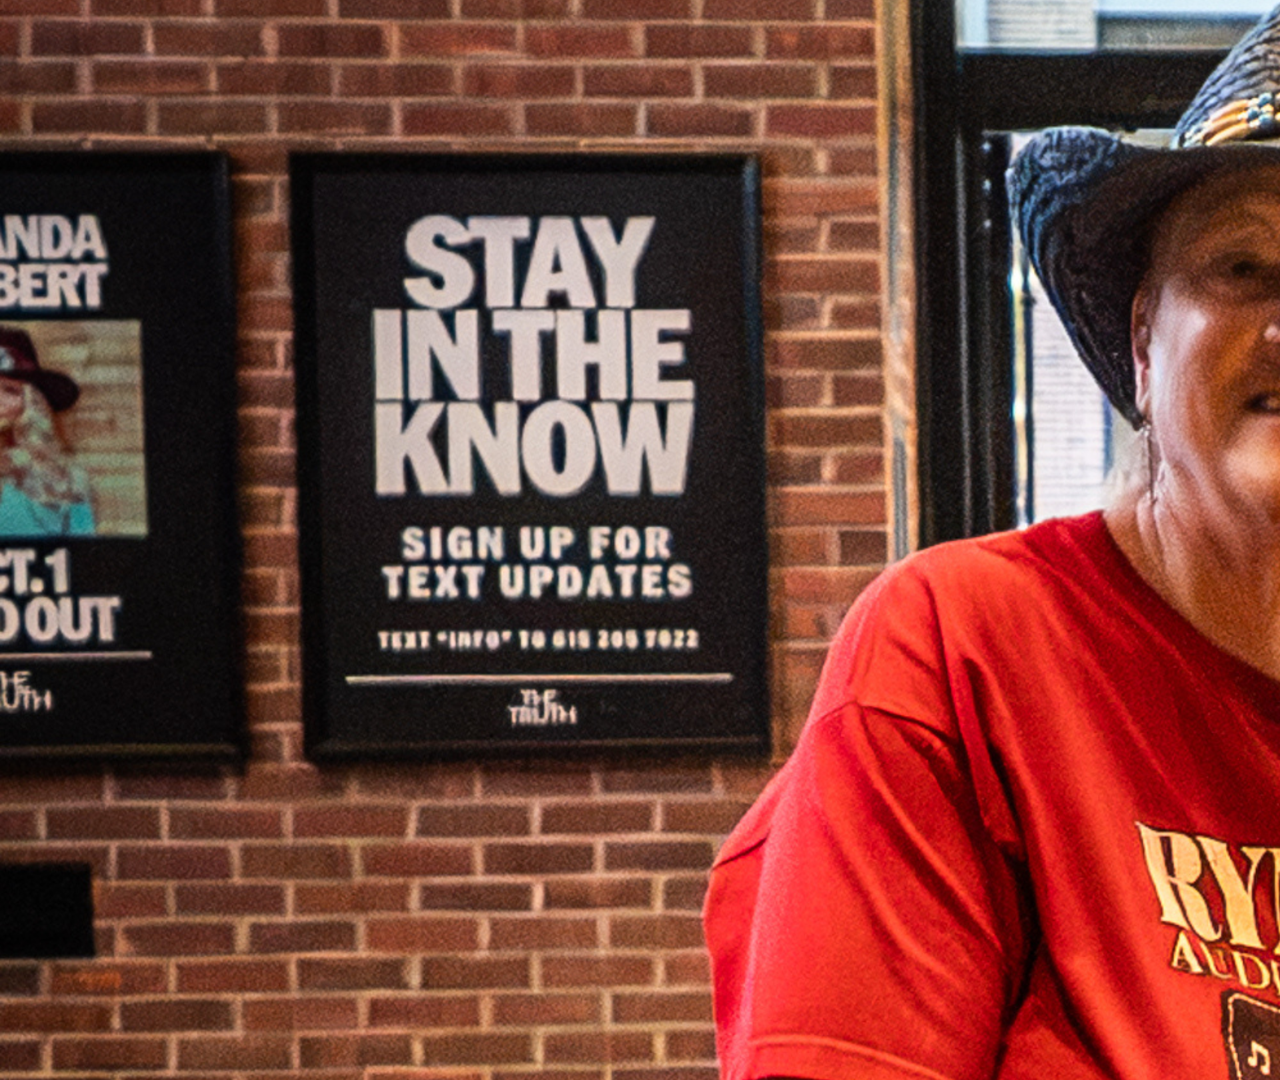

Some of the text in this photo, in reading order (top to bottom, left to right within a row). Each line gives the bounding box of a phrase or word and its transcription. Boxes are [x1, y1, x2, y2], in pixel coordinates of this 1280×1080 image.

[0, 214, 107, 259] NDA
[403, 214, 657, 309] STAY
[371, 308, 695, 400] IN THE
[374, 400, 696, 496] KNOW
[402, 526, 673, 561] SIGN UP FOR
[381, 564, 693, 599] TEXT UPDATES
[25, 596, 121, 641] OUT
[378, 630, 430, 649] TEXT
[518, 629, 546, 650] TO
